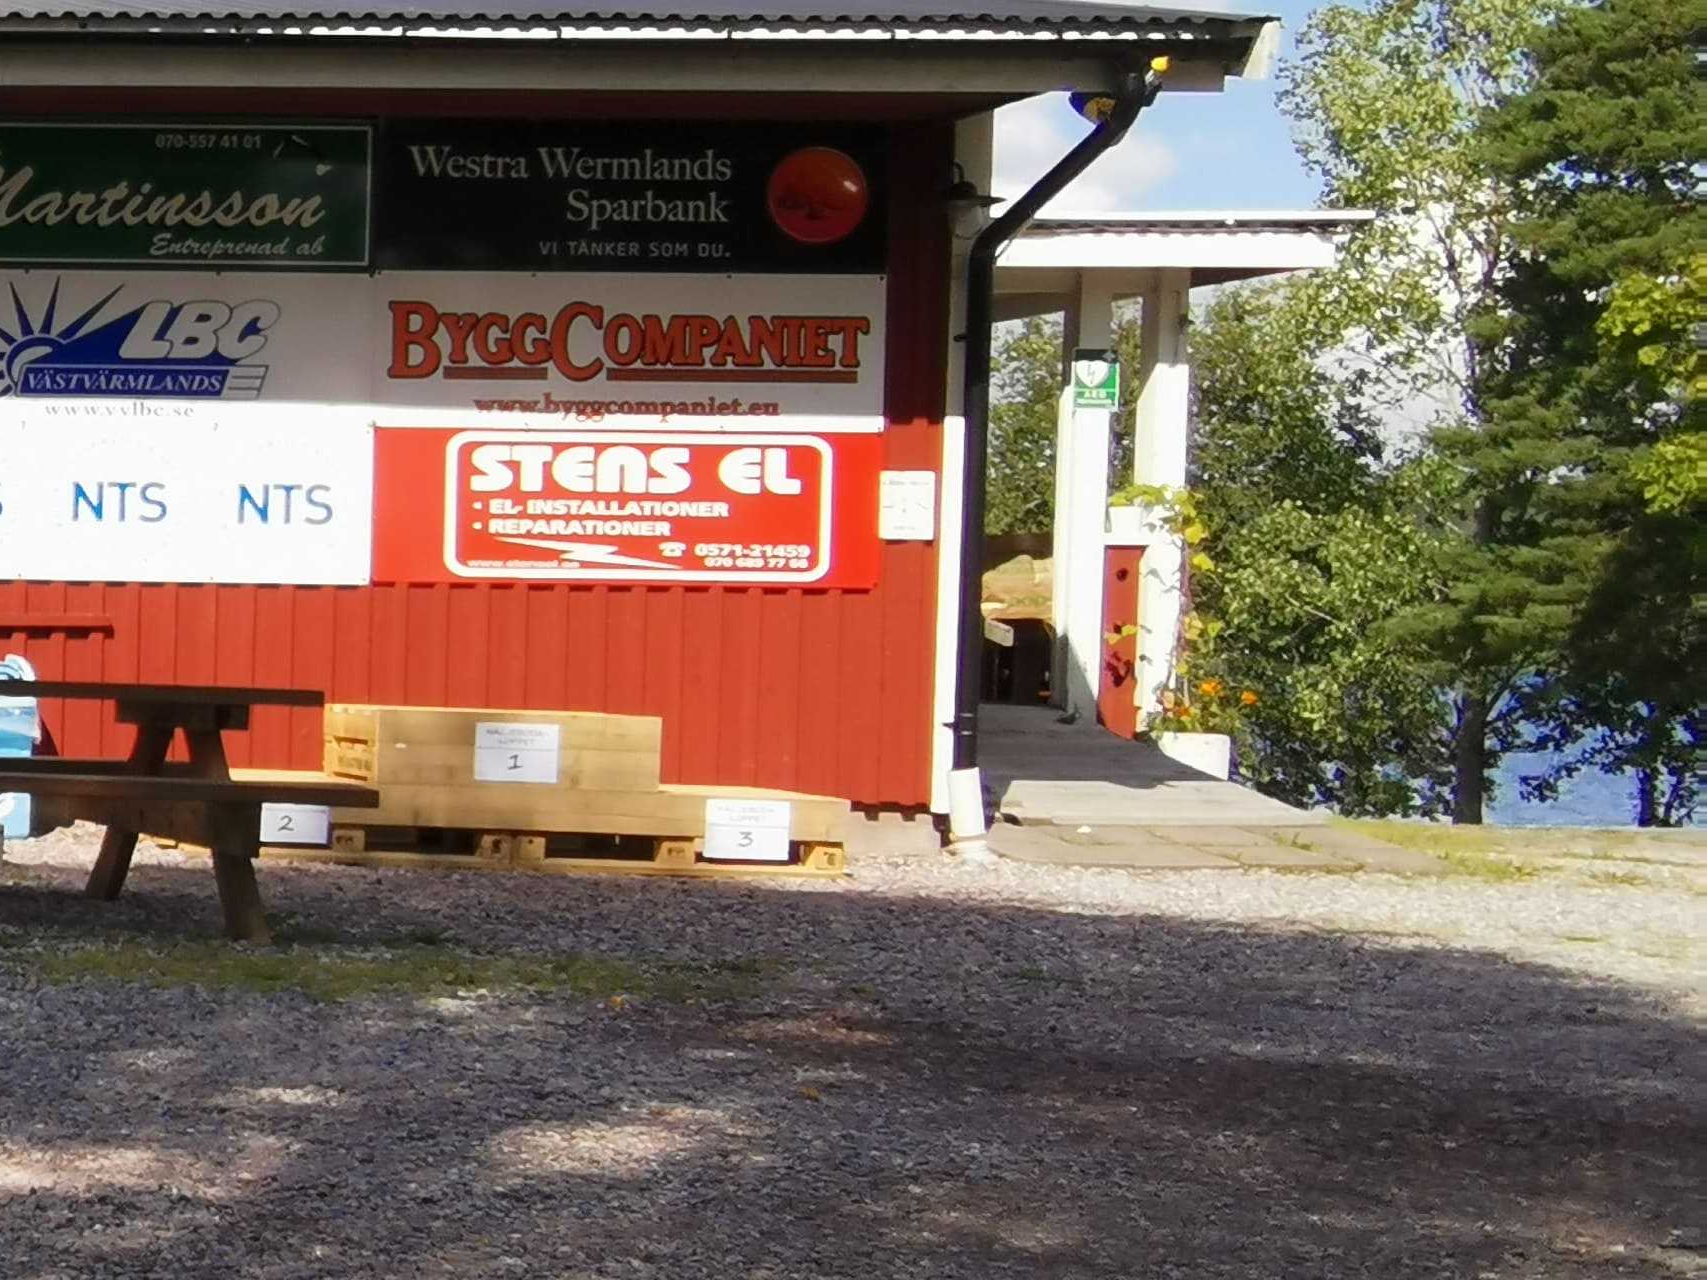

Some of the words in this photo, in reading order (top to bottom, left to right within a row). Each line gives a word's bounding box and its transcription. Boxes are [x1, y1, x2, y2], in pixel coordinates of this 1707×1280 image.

[408, 145, 529, 179] Westra
[537, 147, 732, 182] Wermlands
[566, 187, 731, 231] Sparbank
[149, 232, 290, 258] Entreprenad
[295, 235, 326, 255] ab
[538, 241, 558, 256] VI
[648, 242, 687, 257] SOM
[698, 242, 731, 258] DU.
[118, 299, 281, 362] LBC
[26, 370, 223, 392] VÄSTVÄRMLANDS
[470, 445, 692, 494] STENS
[718, 448, 801, 495] EL
[71, 481, 168, 522] NTS
[236, 484, 334, 525] NTS
[489, 519, 671, 536] REPARATIONER
[507, 754, 523, 770] 1
[277, 815, 295, 832] 2
[736, 831, 754, 847] 3
